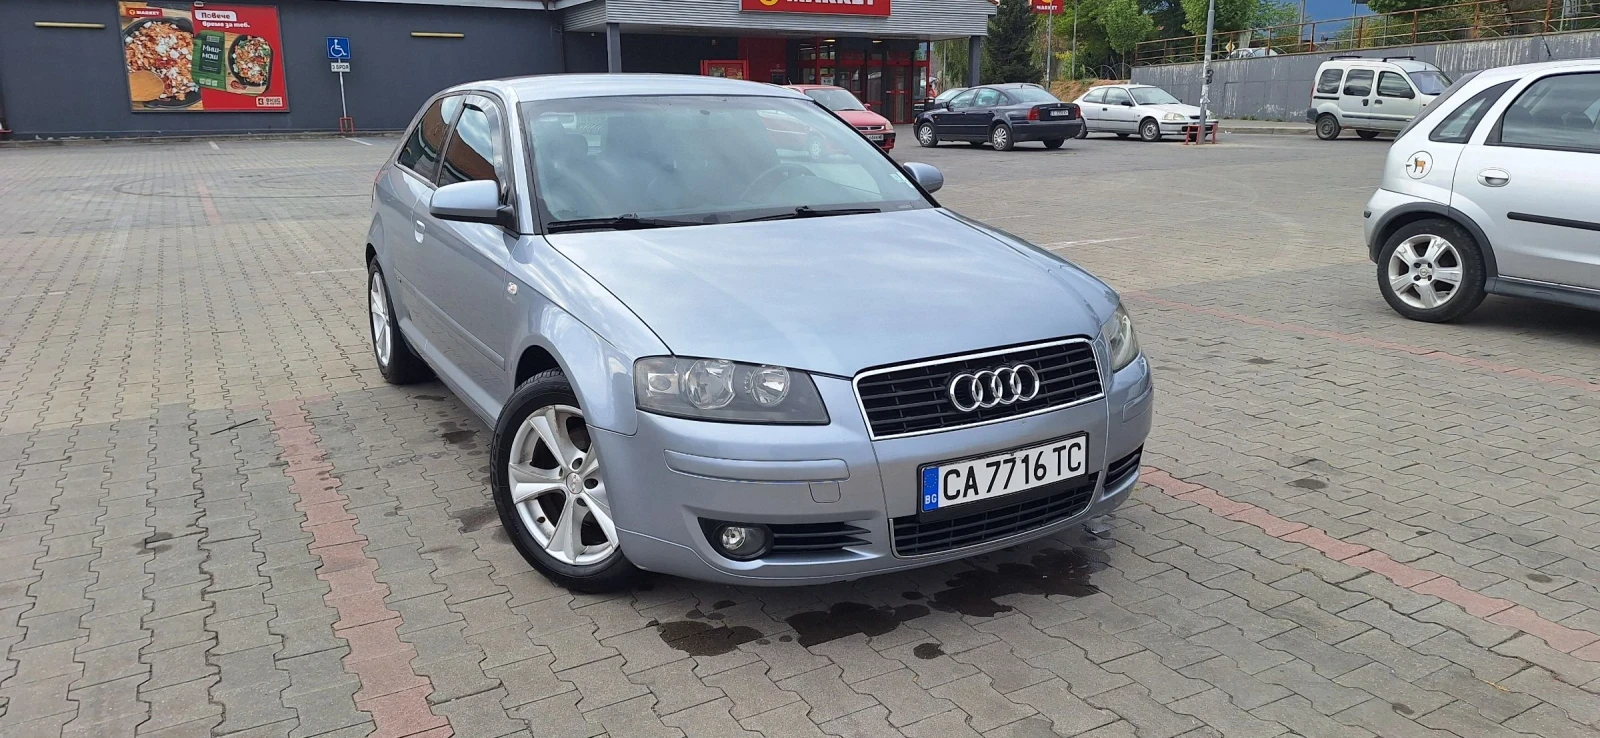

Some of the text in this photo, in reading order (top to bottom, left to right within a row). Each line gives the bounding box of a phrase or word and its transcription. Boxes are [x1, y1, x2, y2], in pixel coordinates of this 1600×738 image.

[201, 12, 231, 20] Повече
[943, 442, 1082, 501] CA 7716 TC
[924, 493, 937, 505] BG
